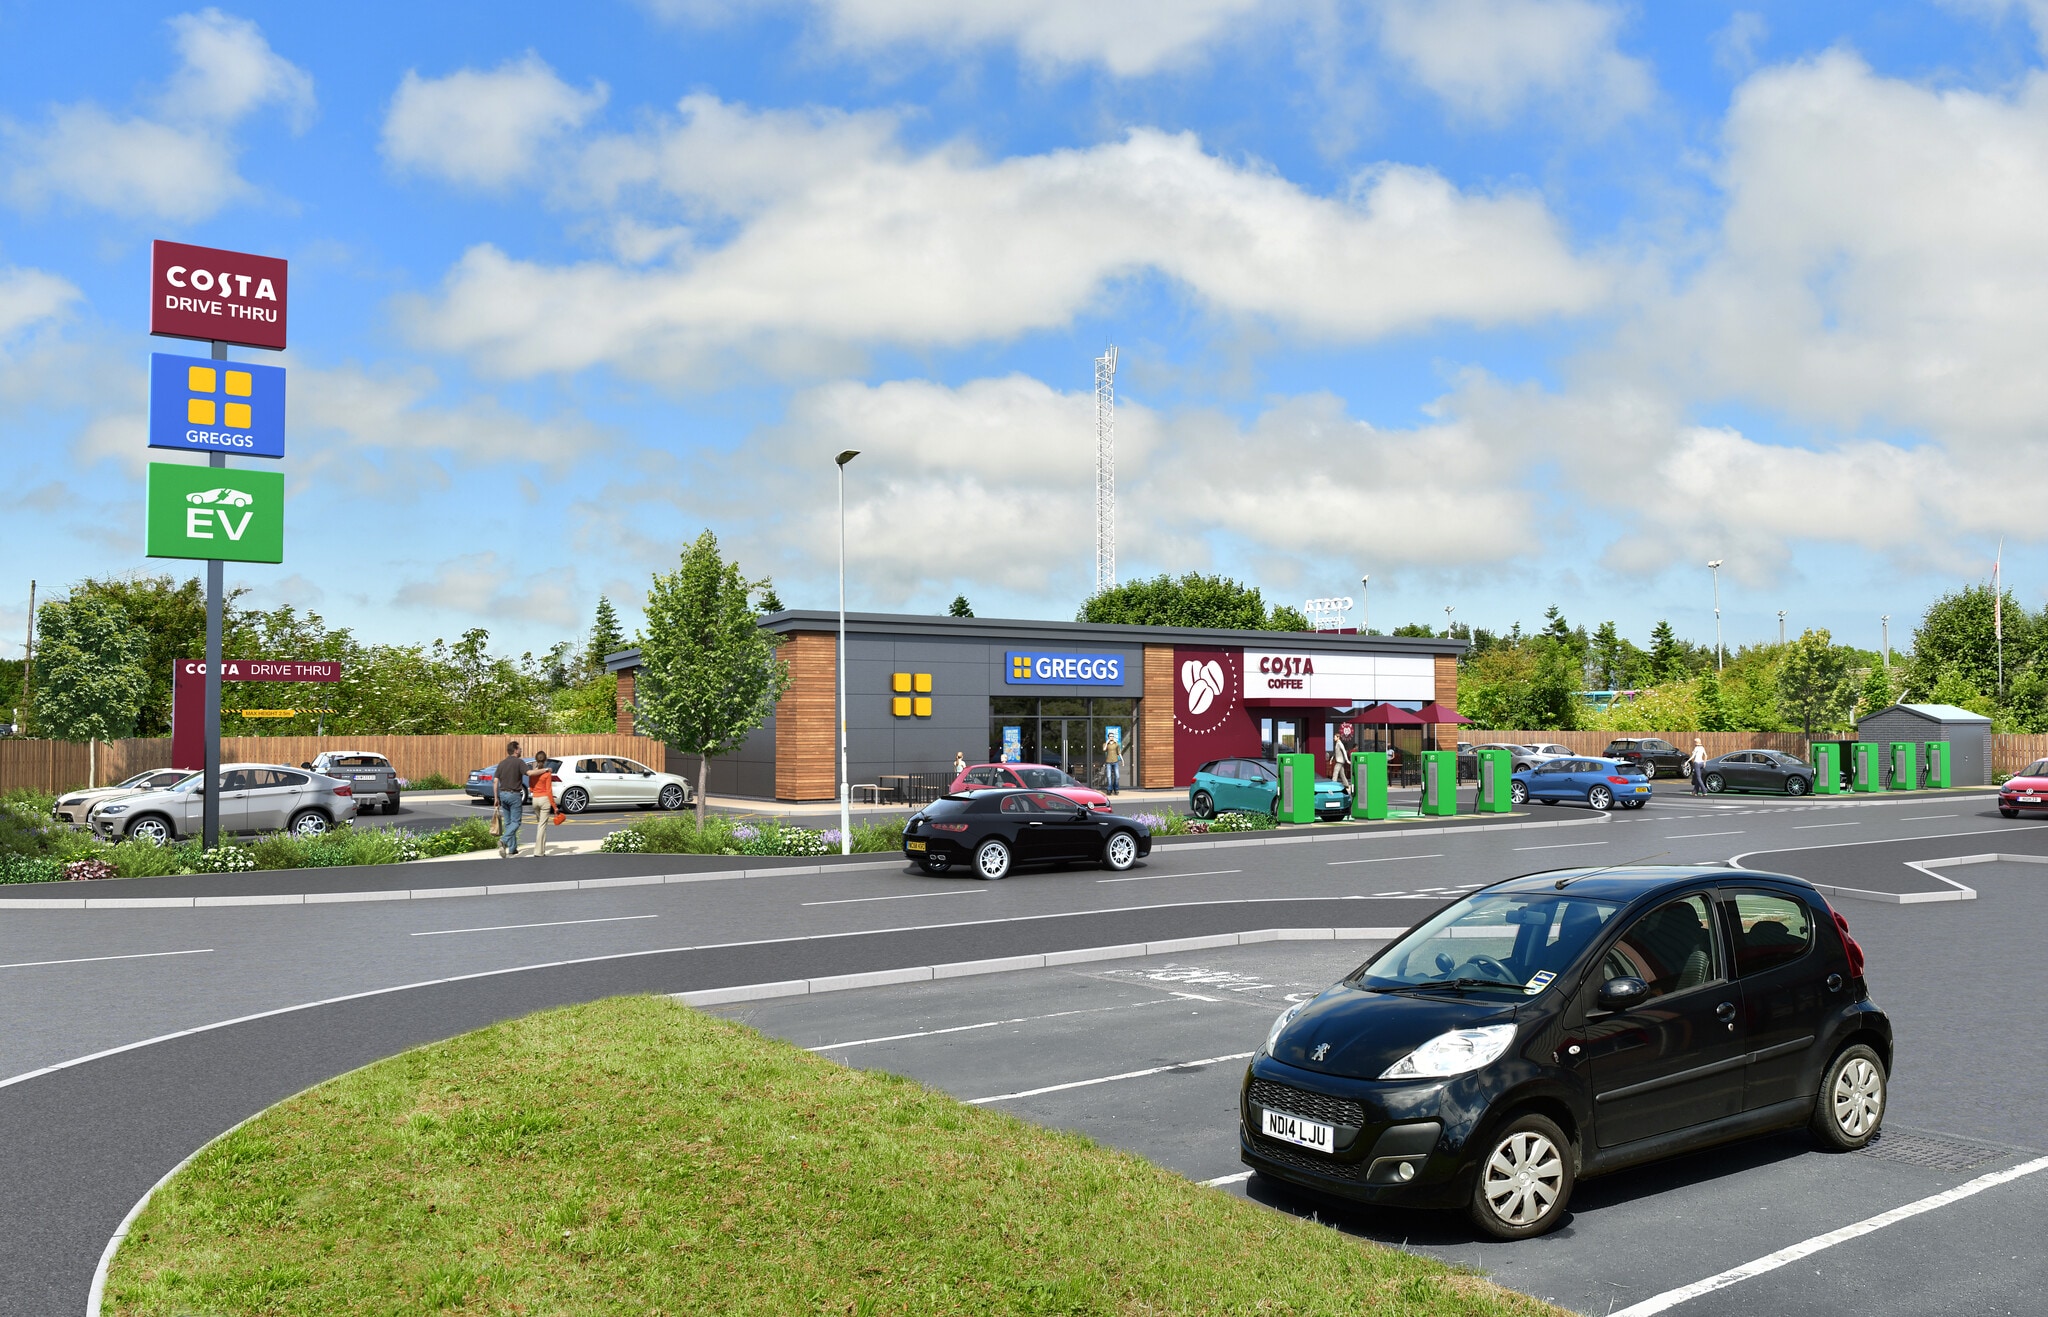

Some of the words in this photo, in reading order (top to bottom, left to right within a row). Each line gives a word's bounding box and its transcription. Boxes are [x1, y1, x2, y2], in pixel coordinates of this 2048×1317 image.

[166, 265, 277, 301] COSTA
[166, 295, 223, 316] DRIVE
[227, 303, 278, 323] THRU
[186, 430, 254, 447] GREGGS
[186, 507, 254, 541] EV
[185, 663, 239, 675] COTA
[251, 664, 291, 675] DRIVE
[295, 665, 331, 676] THRU
[1036, 657, 1118, 680] GREGGS
[1259, 656, 1314, 677] COSTA
[1267, 678, 1303, 690] COFFEE
[1270, 1113, 1295, 1138] ND14
[1299, 1121, 1325, 1146] LJU
